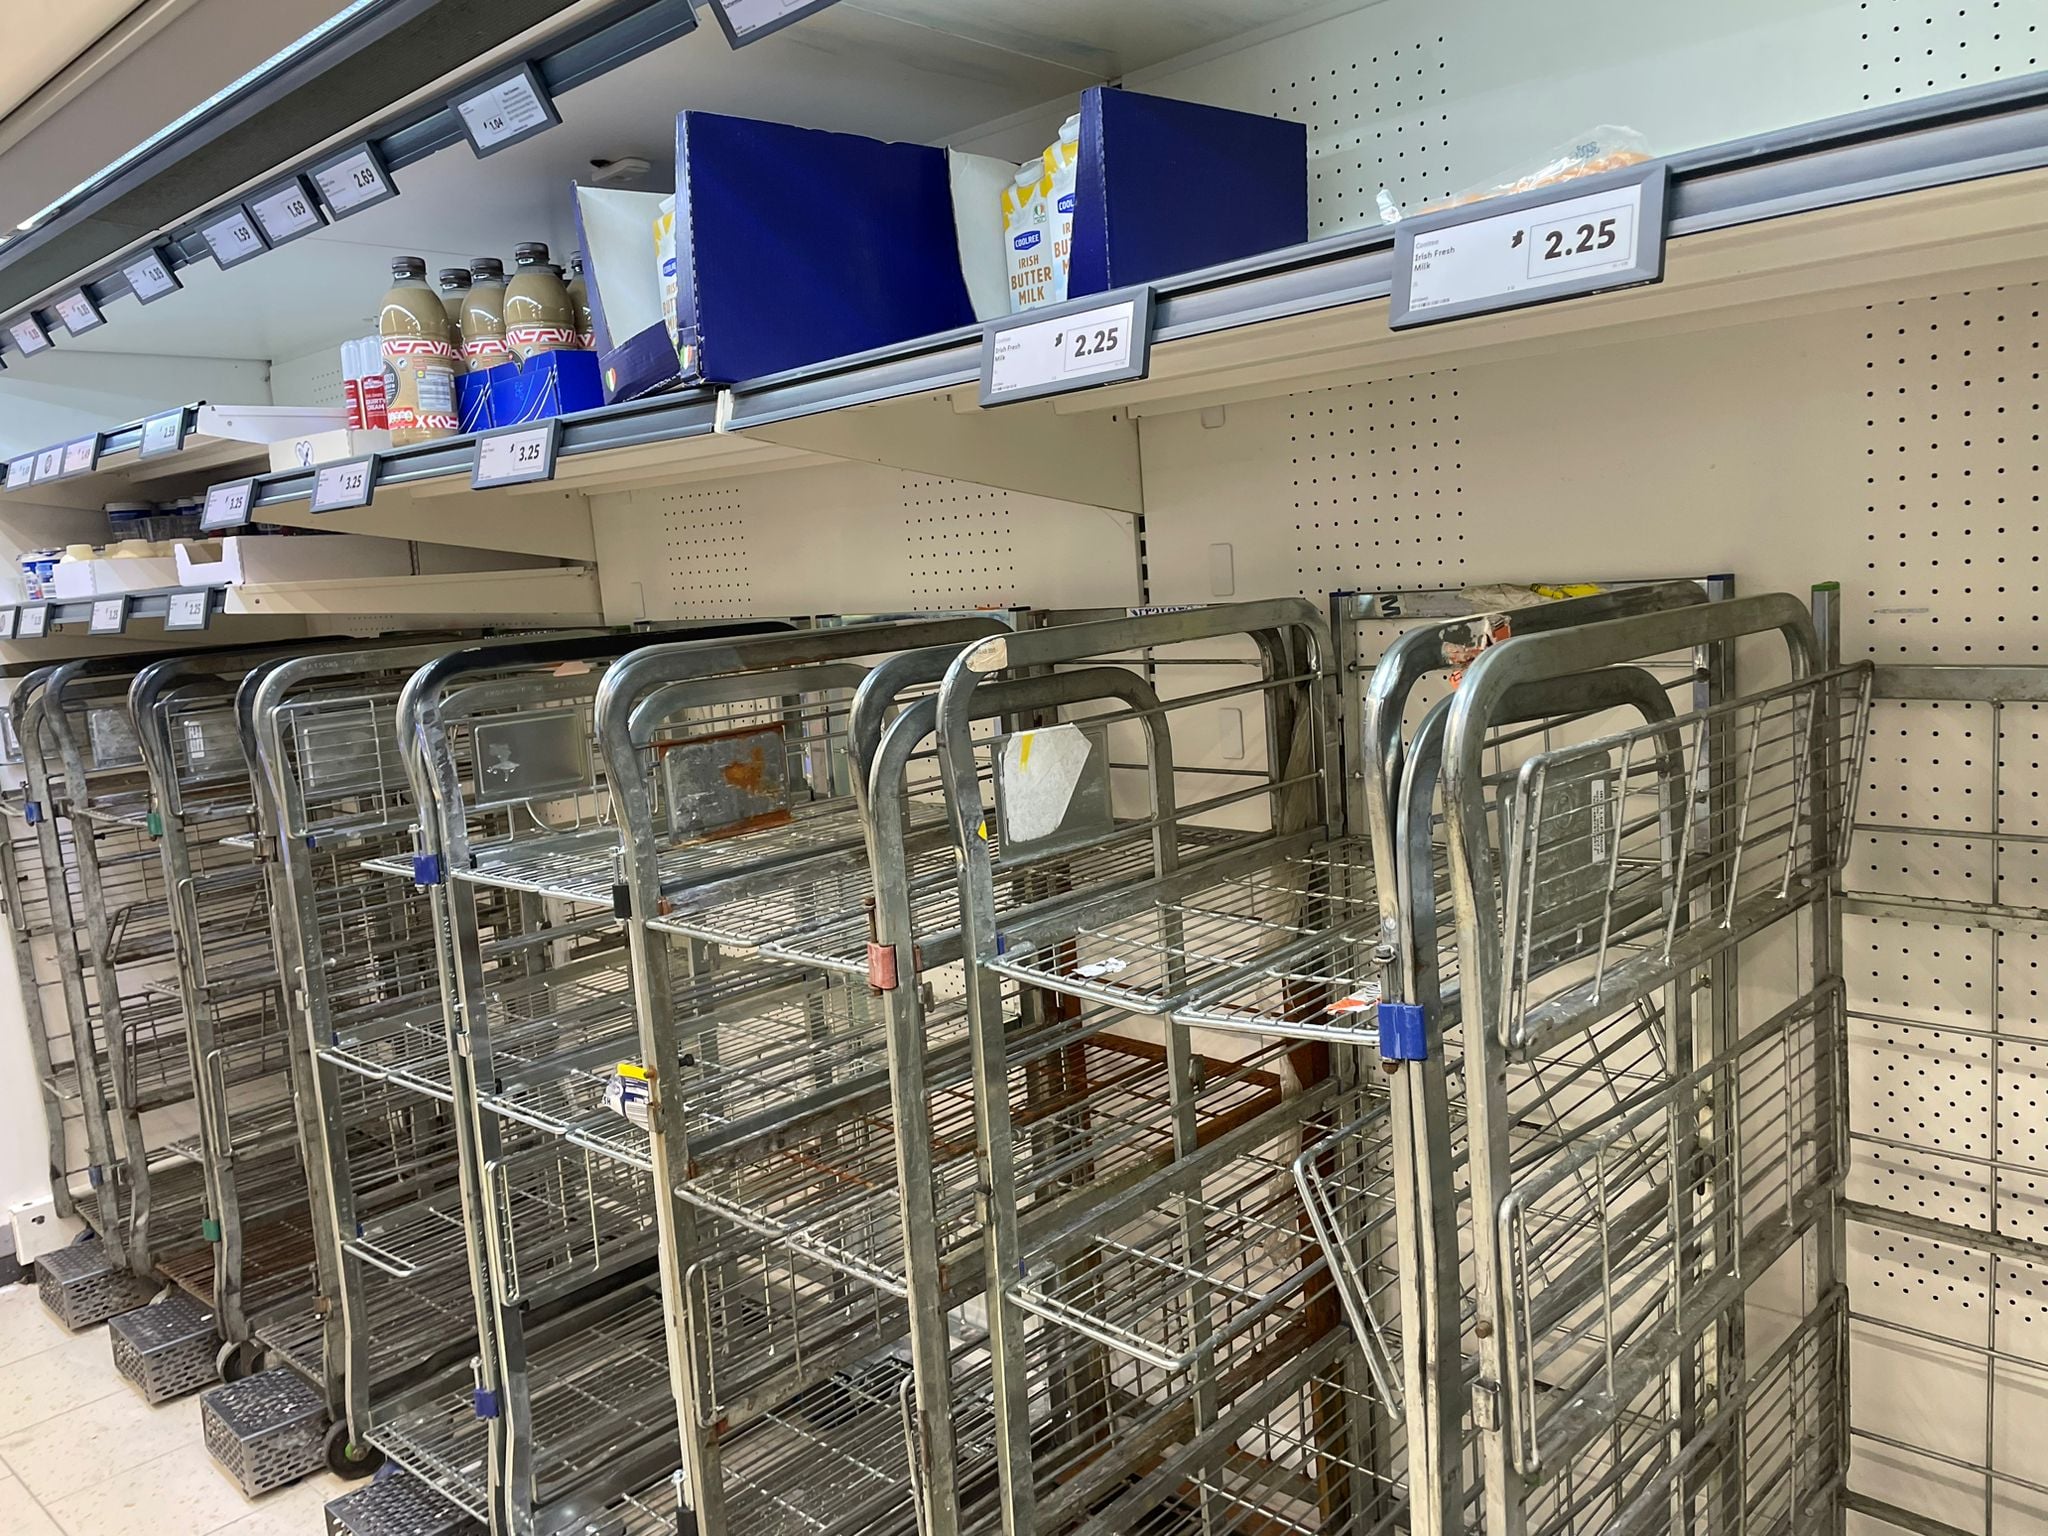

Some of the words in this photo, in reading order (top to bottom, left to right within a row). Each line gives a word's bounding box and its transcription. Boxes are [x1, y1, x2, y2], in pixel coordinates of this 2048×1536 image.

[353, 168, 375, 188] 2.69
[287, 200, 306, 218] 1.69
[233, 226, 251, 242] 1.59
[1015, 233, 1040, 249] COOLREE
[1544, 218, 1616, 260] 2.25
[1018, 254, 1039, 270] IRISH
[1414, 250, 1433, 262] Irish
[1434, 246, 1455, 258] Fresh
[1414, 262, 1431, 272] Milk
[1010, 266, 1053, 291] BUTTER
[1018, 285, 1046, 306] MILK
[1074, 327, 1119, 358] 2.25
[519, 443, 540, 462] 3.25
[345, 474, 362, 490] 3.25
